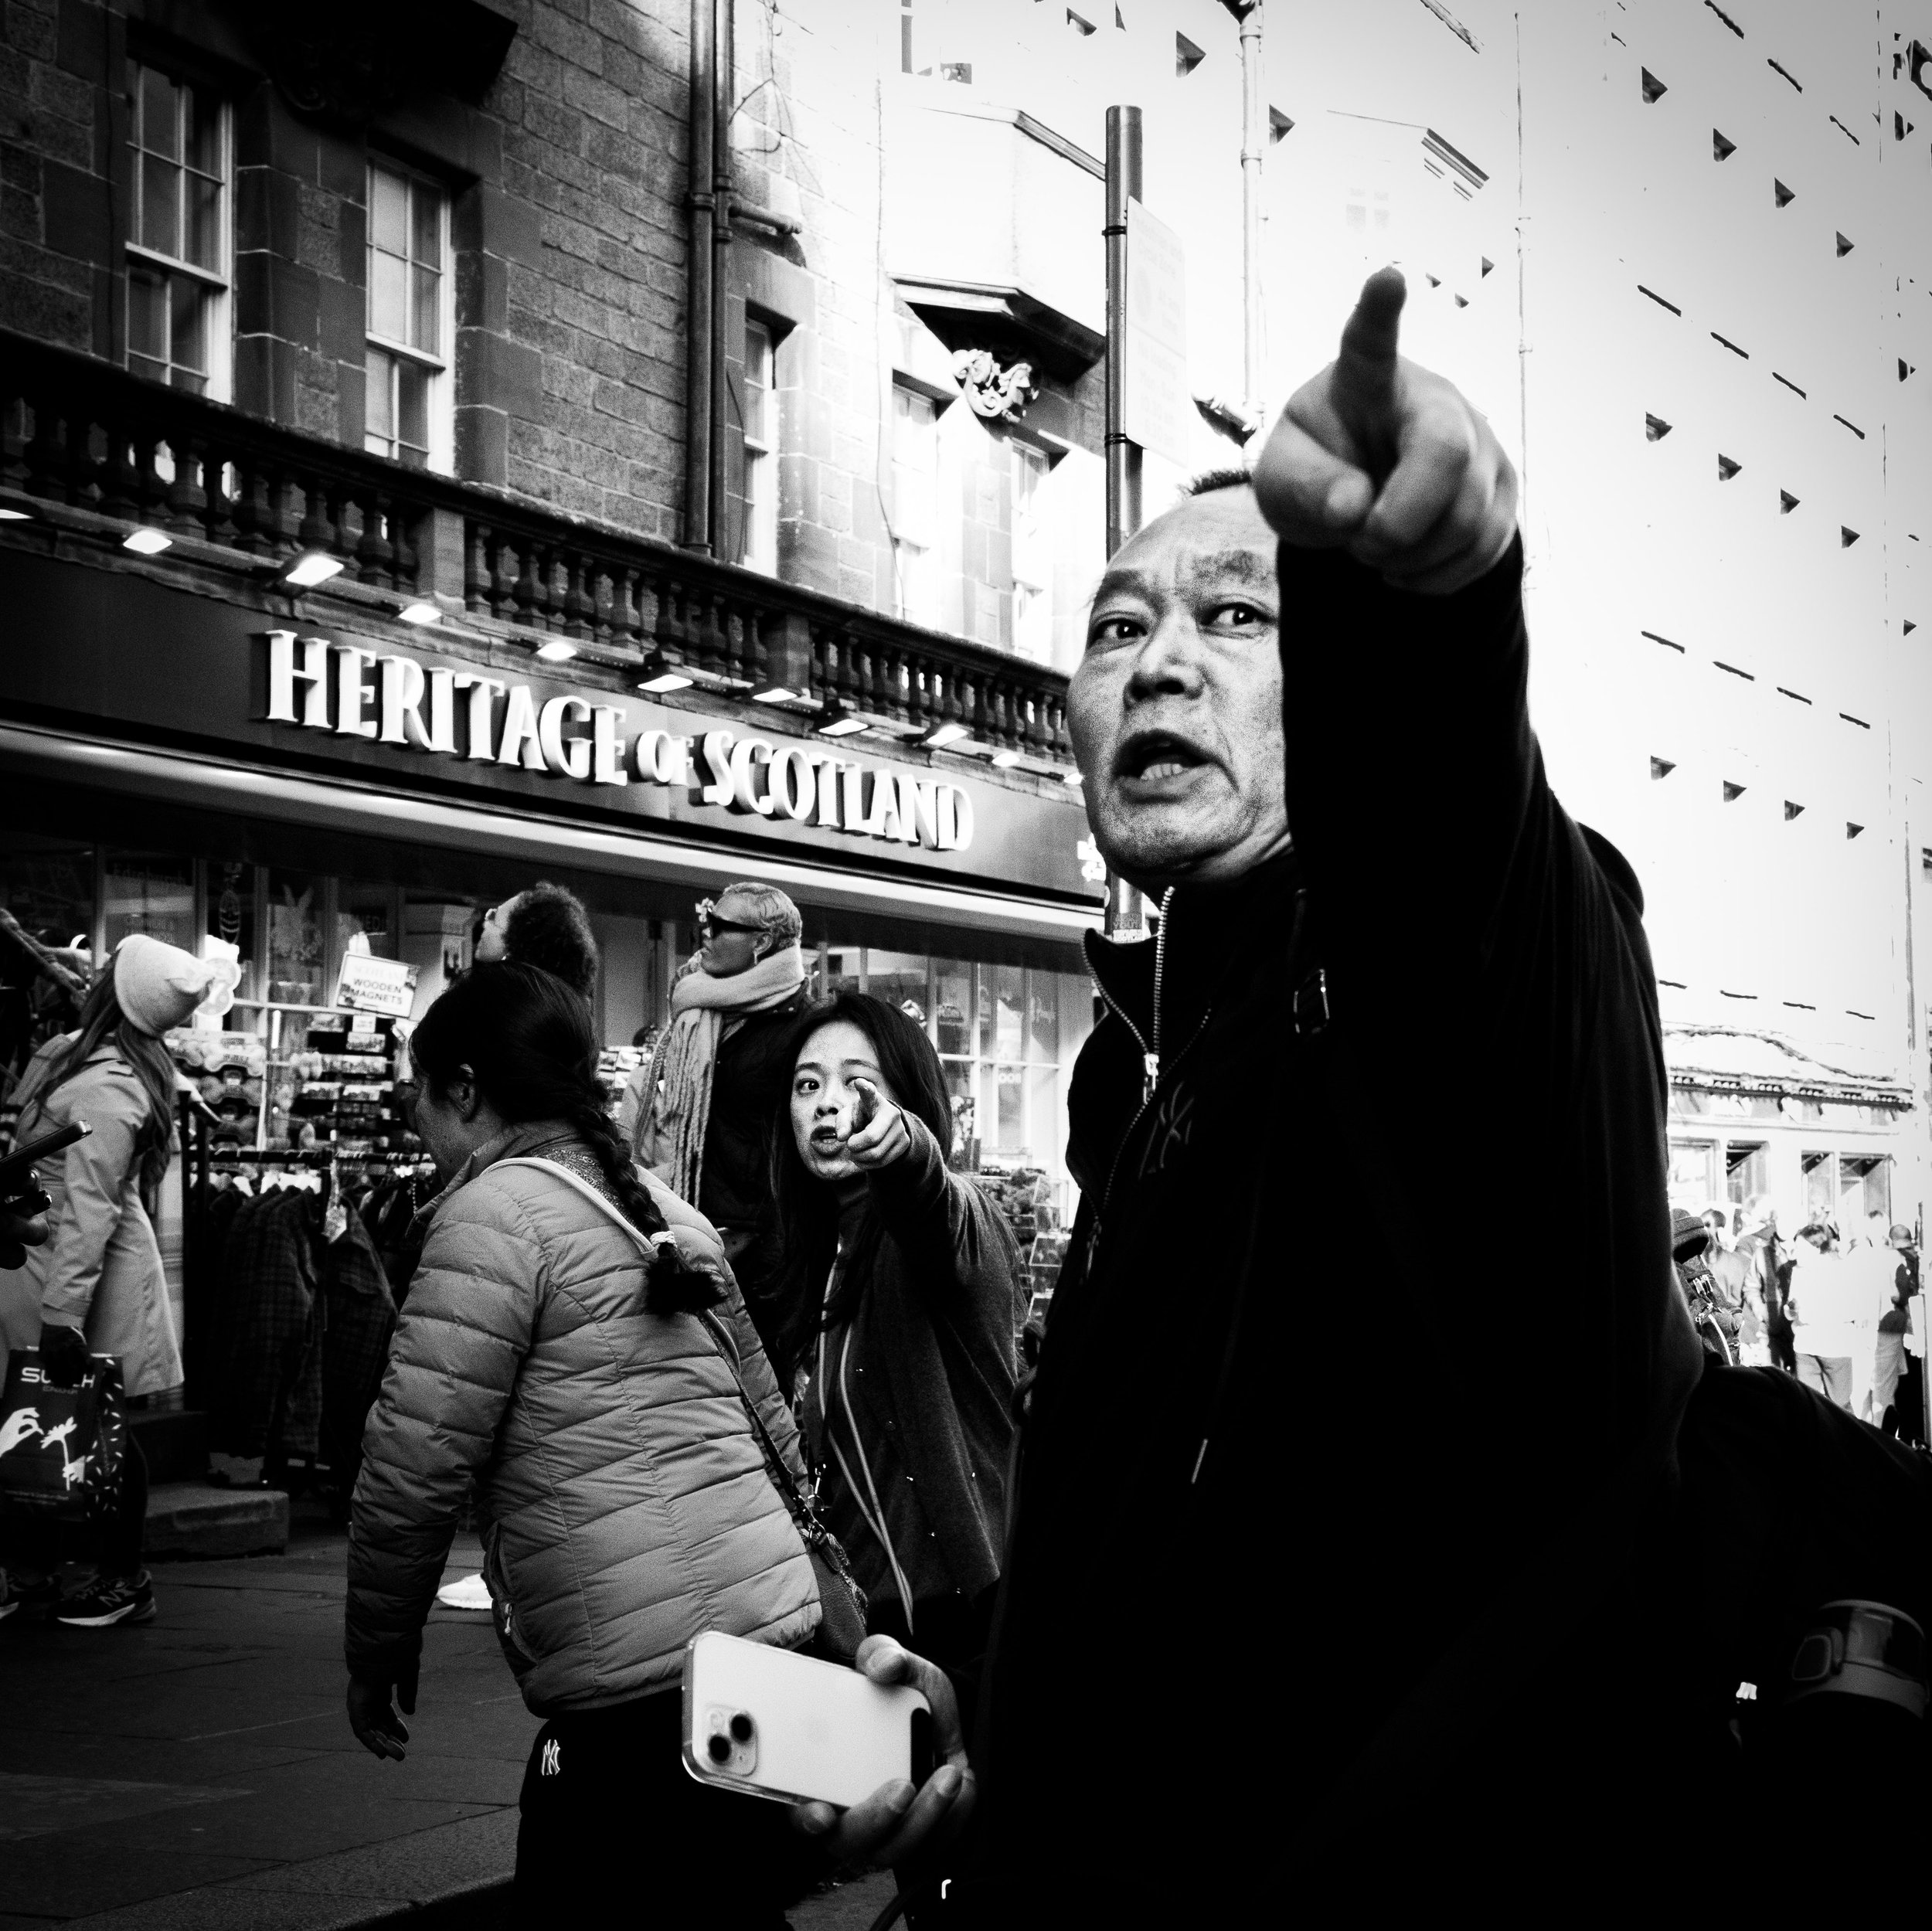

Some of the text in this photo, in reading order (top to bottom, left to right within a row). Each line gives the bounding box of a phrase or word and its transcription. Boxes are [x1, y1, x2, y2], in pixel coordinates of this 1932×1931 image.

[264, 629, 975, 852] HERITAGE OF SCOTLAND
[350, 988, 403, 1005] MAGNETS
[354, 978, 402, 994] WOODEN
[541, 1739, 561, 1776] NY
